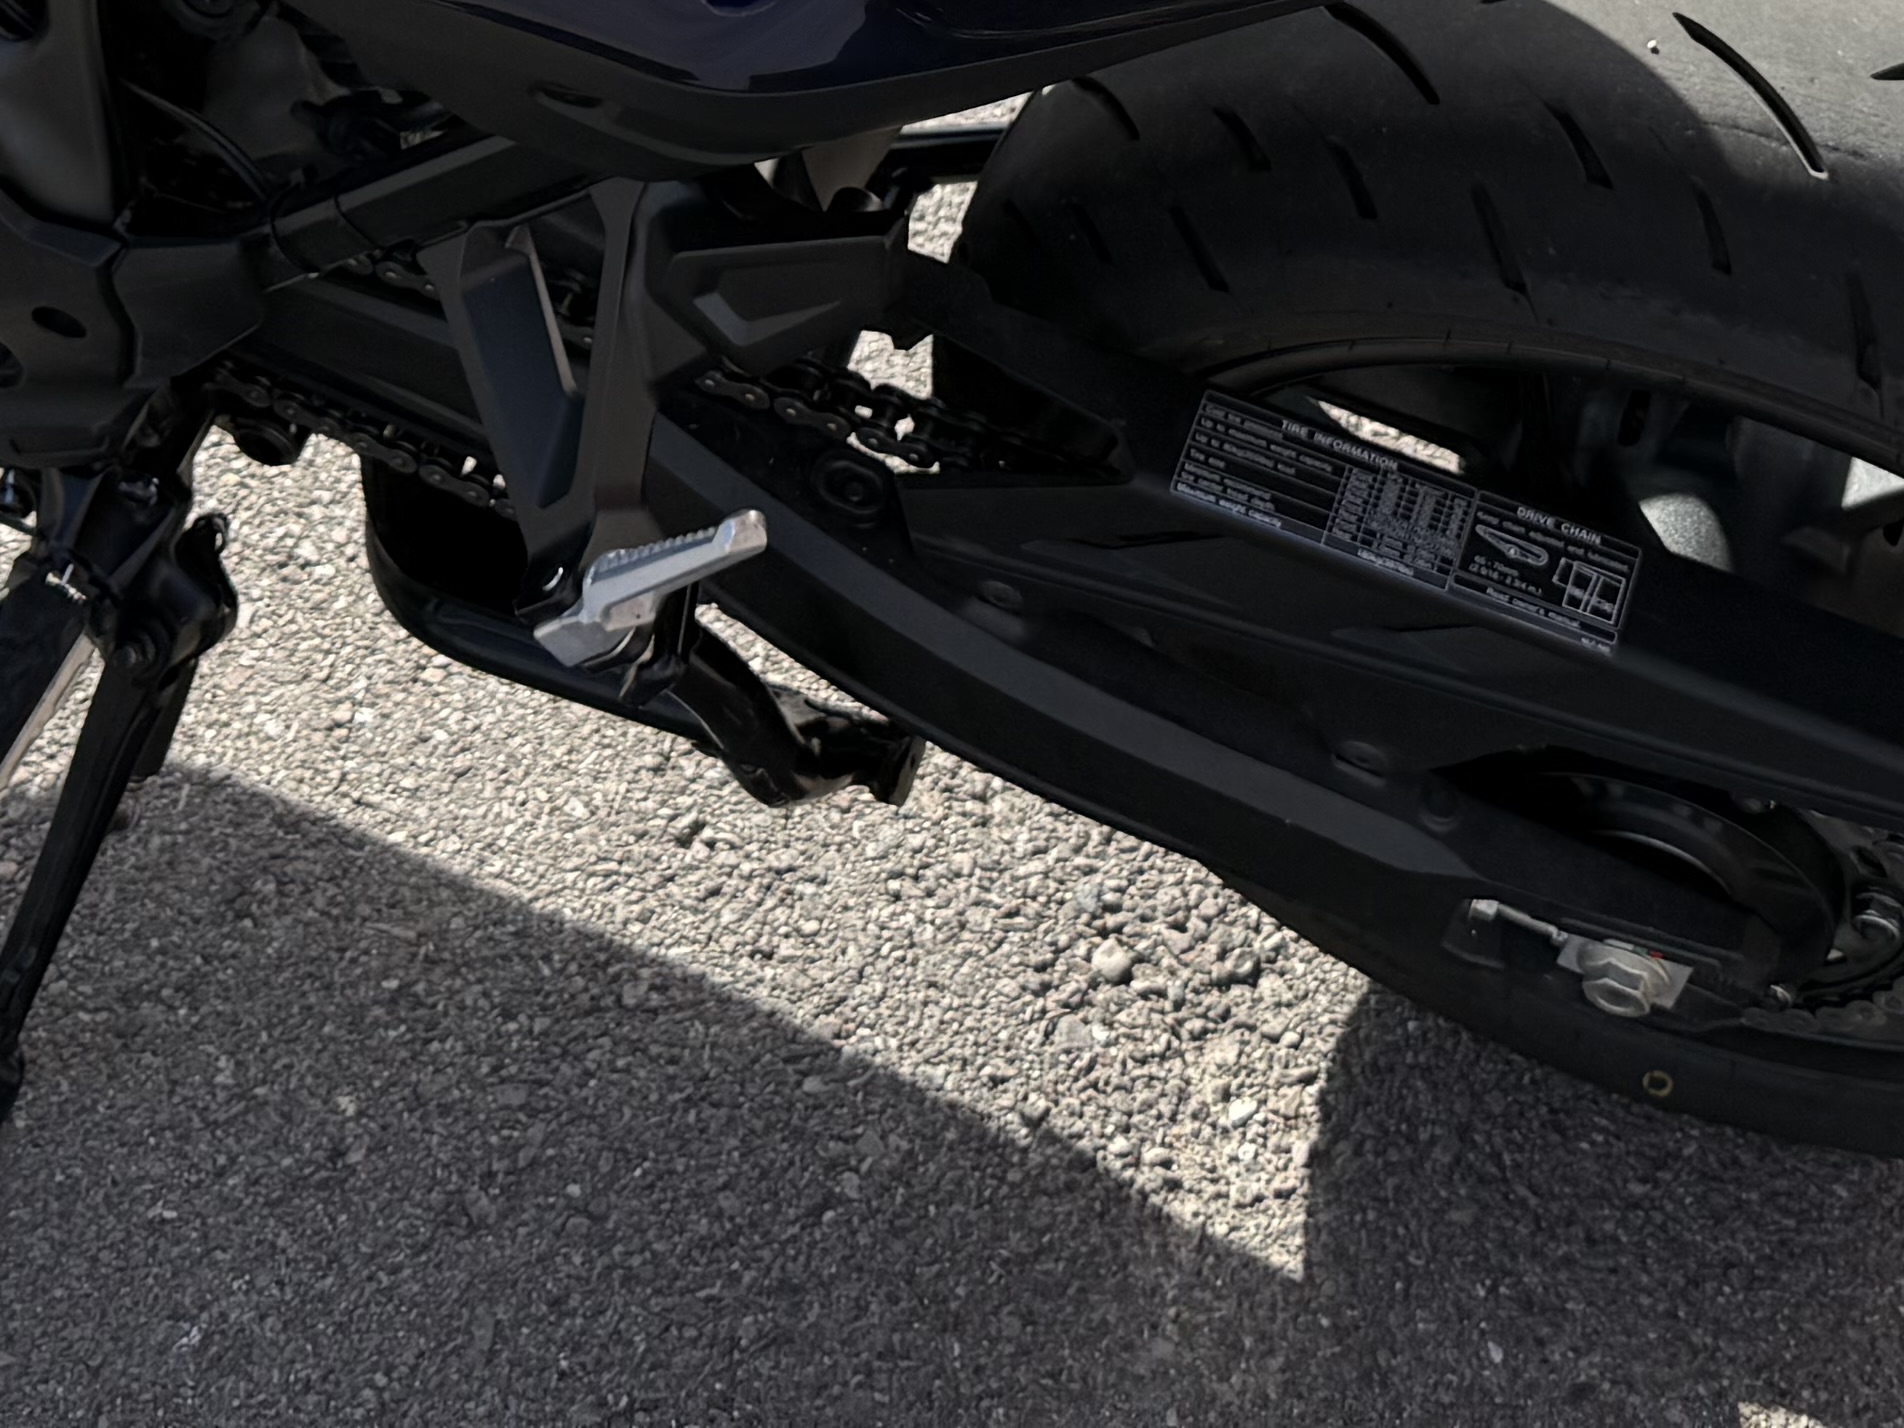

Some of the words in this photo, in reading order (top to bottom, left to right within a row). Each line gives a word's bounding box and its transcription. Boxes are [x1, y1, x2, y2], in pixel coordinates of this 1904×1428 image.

[1282, 419, 1308, 438] TIRE
[1313, 432, 1398, 471] INFORMATION
[1516, 506, 1555, 529] DRIVE
[1560, 522, 1601, 547] CHAIN
